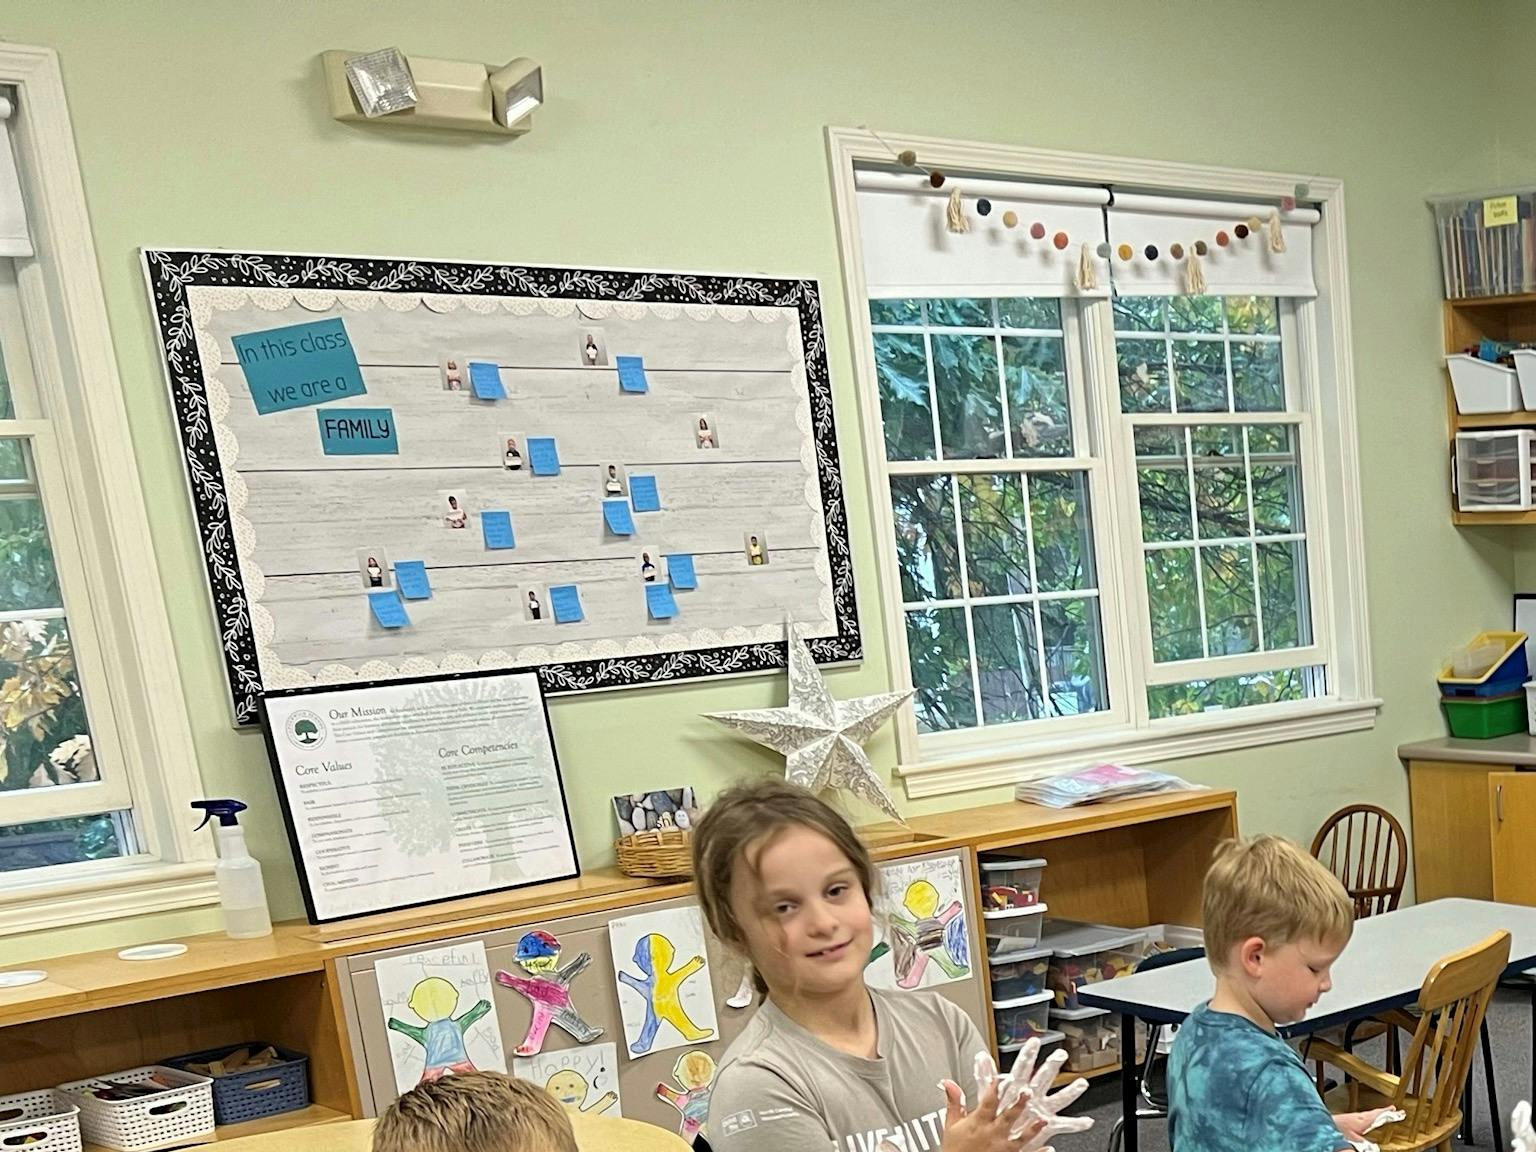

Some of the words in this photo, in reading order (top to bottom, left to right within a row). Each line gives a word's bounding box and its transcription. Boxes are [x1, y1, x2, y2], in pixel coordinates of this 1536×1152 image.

[238, 344, 259, 364] In
[262, 339, 297, 361] this
[300, 332, 347, 354] class
[268, 384, 297, 404] we
[301, 378, 330, 398] are
[335, 376, 348, 392] a
[325, 419, 390, 440] FAMILY
[328, 709, 349, 721] Our
[351, 706, 387, 718] Mission
[438, 747, 459, 759] Core
[461, 742, 519, 756] Competencies
[295, 765, 320, 776] Core
[322, 760, 353, 773] Values
